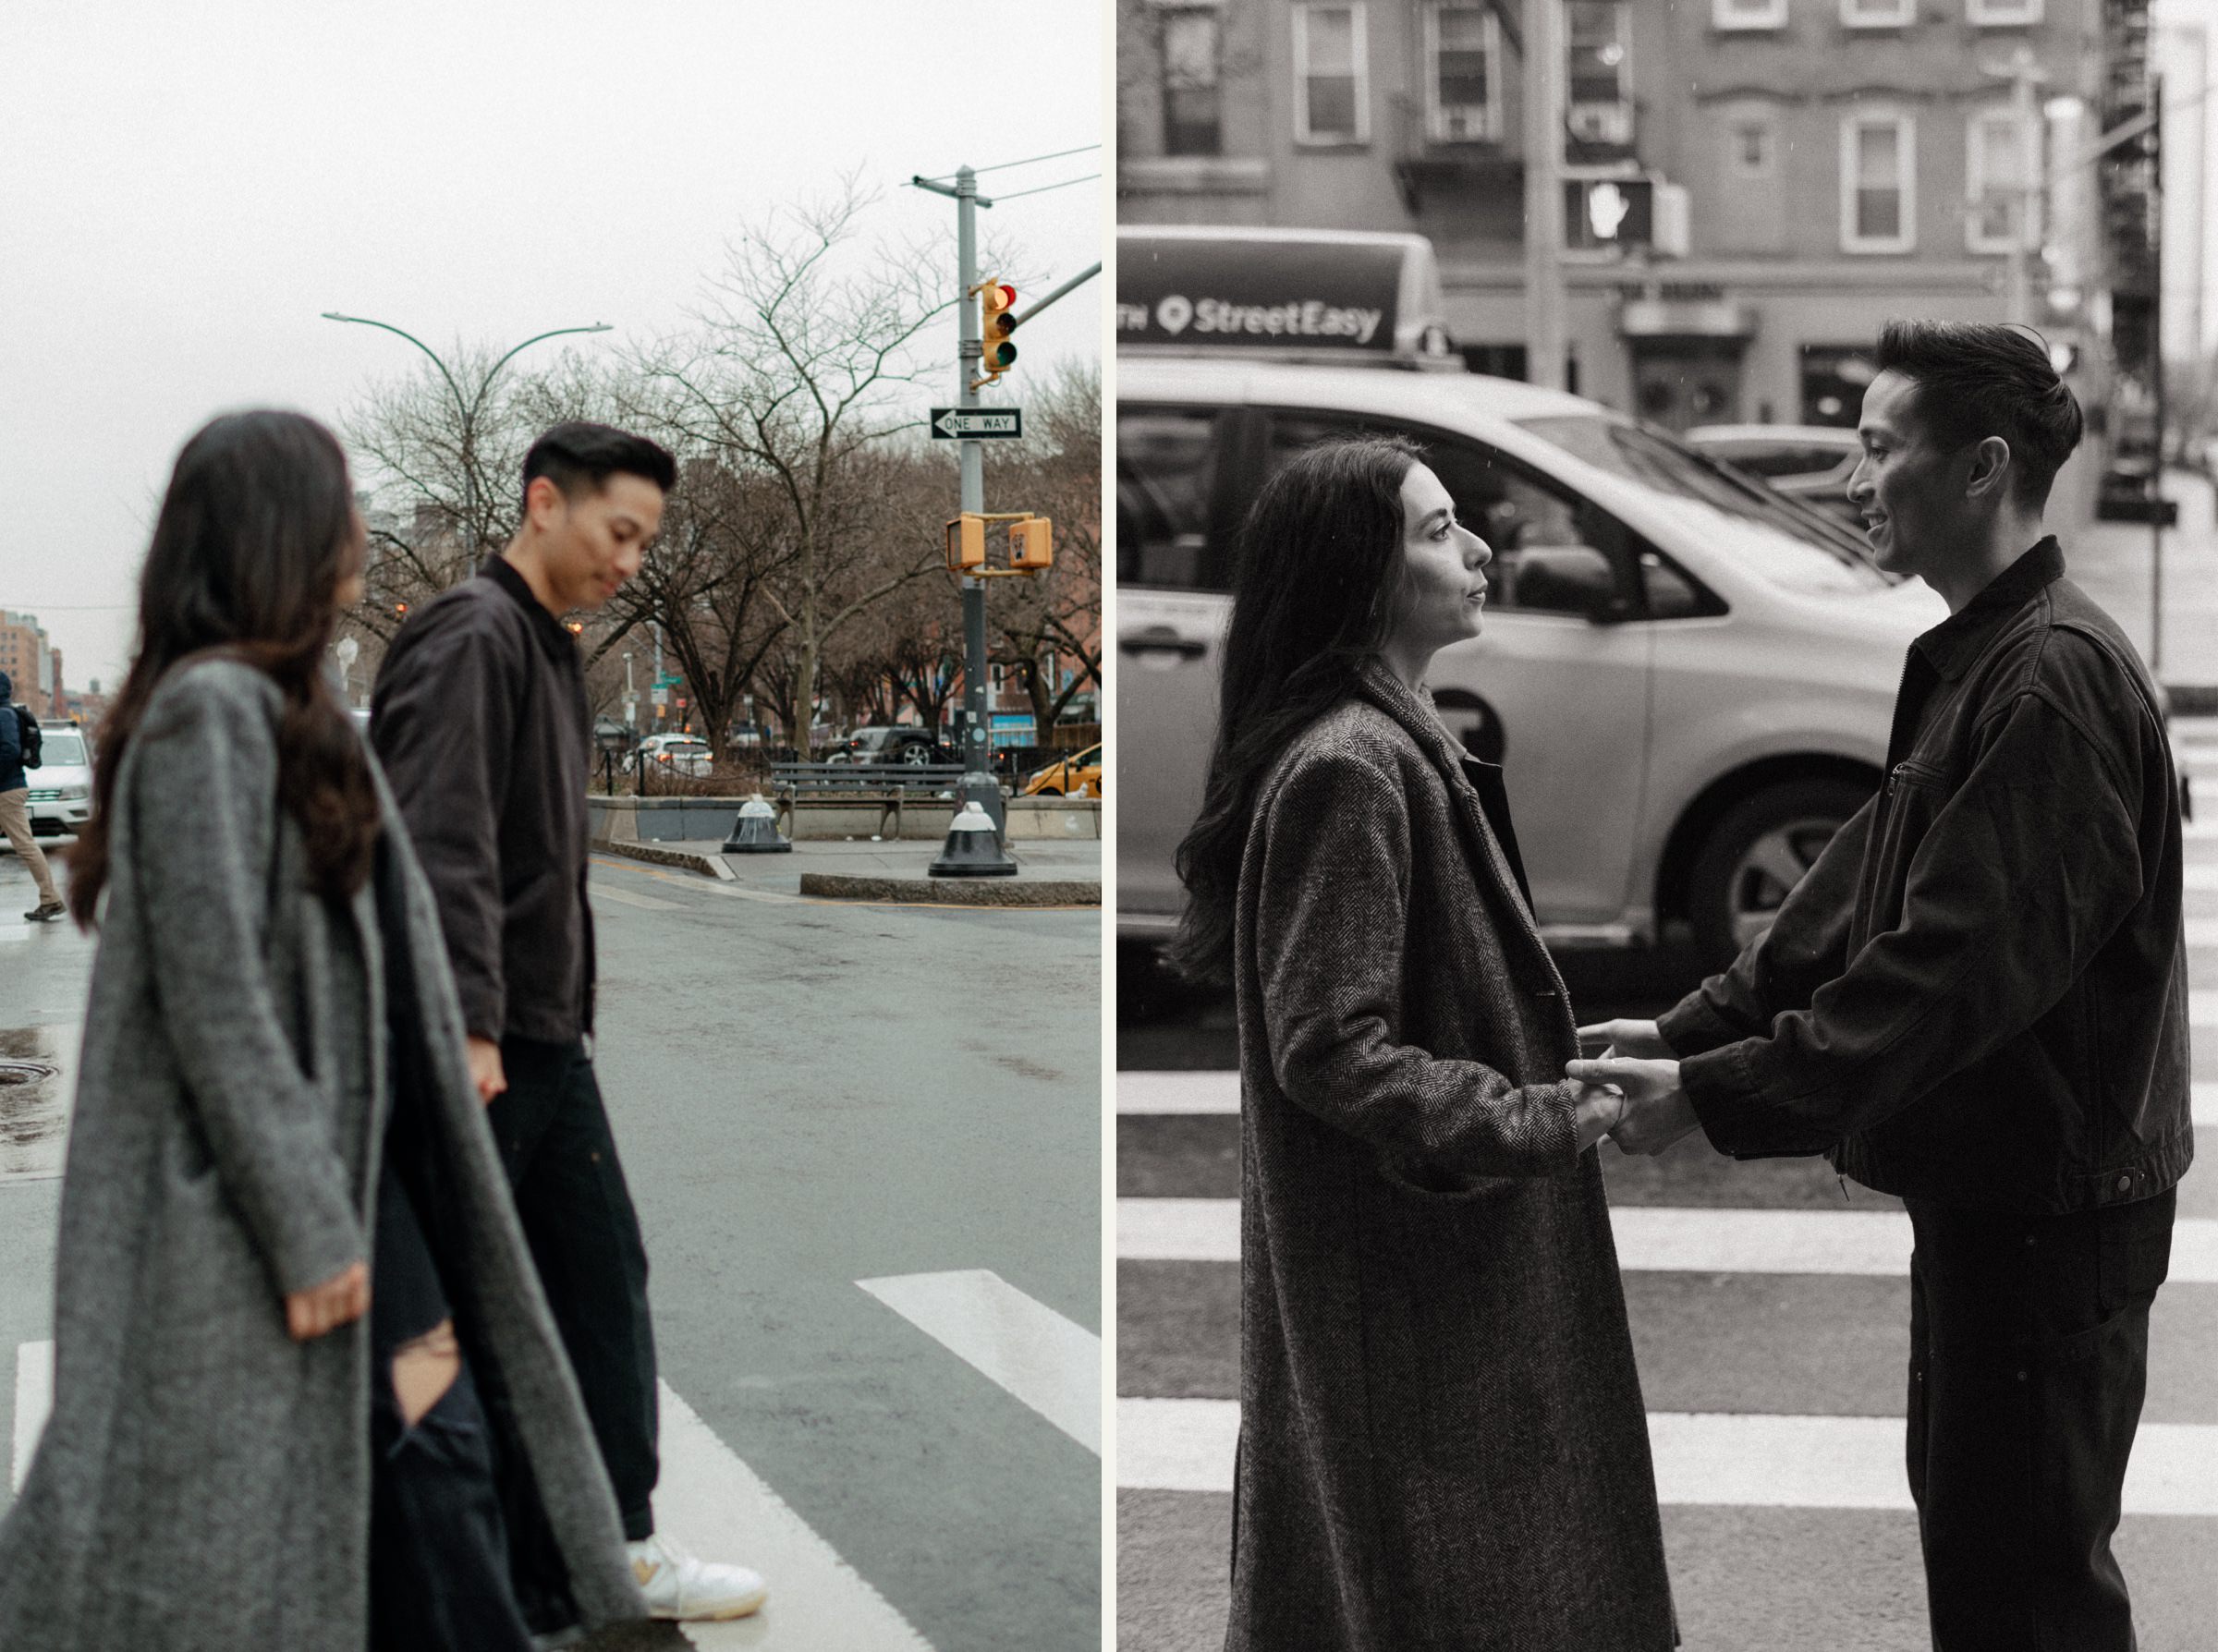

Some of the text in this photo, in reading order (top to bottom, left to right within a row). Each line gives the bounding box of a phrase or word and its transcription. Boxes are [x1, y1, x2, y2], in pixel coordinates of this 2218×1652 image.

[1193, 298, 1382, 345] StreetEasy
[944, 418, 1009, 430] ONE WAY
